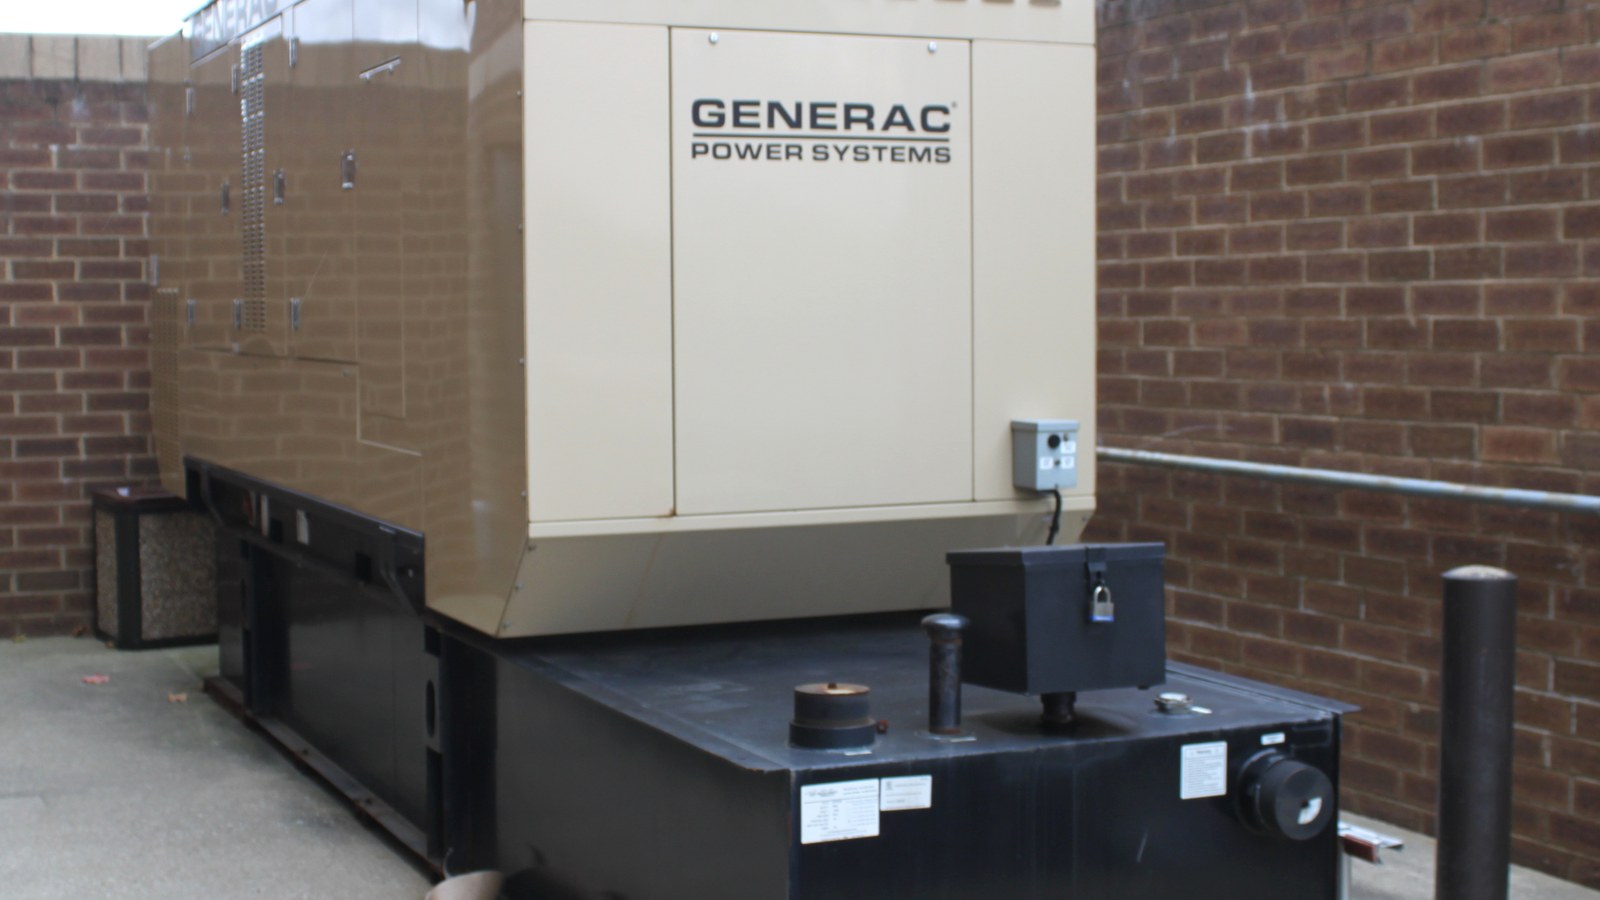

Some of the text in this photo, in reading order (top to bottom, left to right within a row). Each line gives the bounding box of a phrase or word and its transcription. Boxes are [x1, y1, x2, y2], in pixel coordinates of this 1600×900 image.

[691, 98, 951, 133] GENERAC
[691, 142, 951, 163] POWER SYSTEMS
